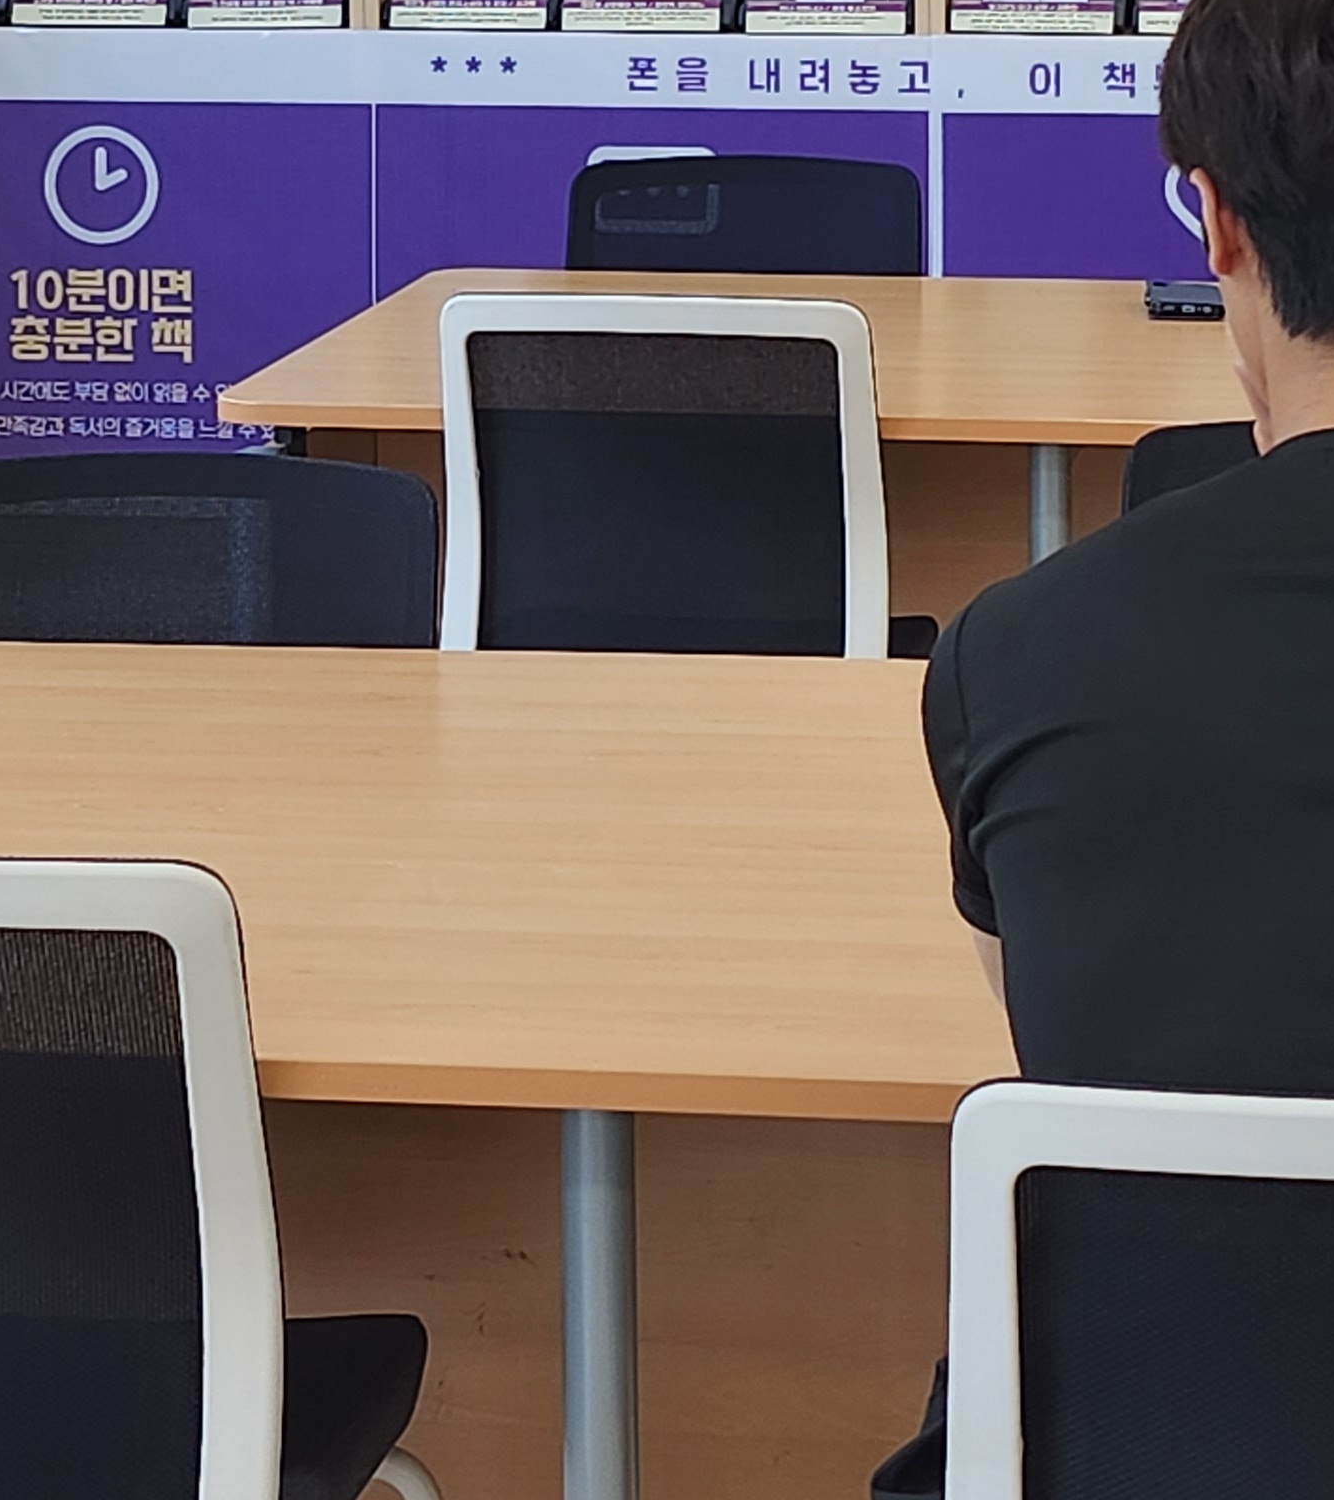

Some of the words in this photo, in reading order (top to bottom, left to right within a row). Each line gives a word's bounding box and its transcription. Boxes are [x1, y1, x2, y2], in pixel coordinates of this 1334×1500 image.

[625, 55, 710, 94] 폰을
[746, 56, 966, 101] 내려놓고,
[1027, 60, 1062, 99] 이
[1101, 61, 1138, 100] 책
[9, 267, 194, 315] 10분이면
[8, 315, 138, 363] 충분한
[150, 317, 194, 363] 책
[0, 379, 72, 402] 시간에도
[73, 380, 110, 402] 부담
[112, 380, 150, 403] 없이
[151, 380, 189, 404] 읽을
[191, 382, 212, 404] 수
[68, 415, 122, 438] 독서의
[124, 415, 195, 439] 즐거움을
